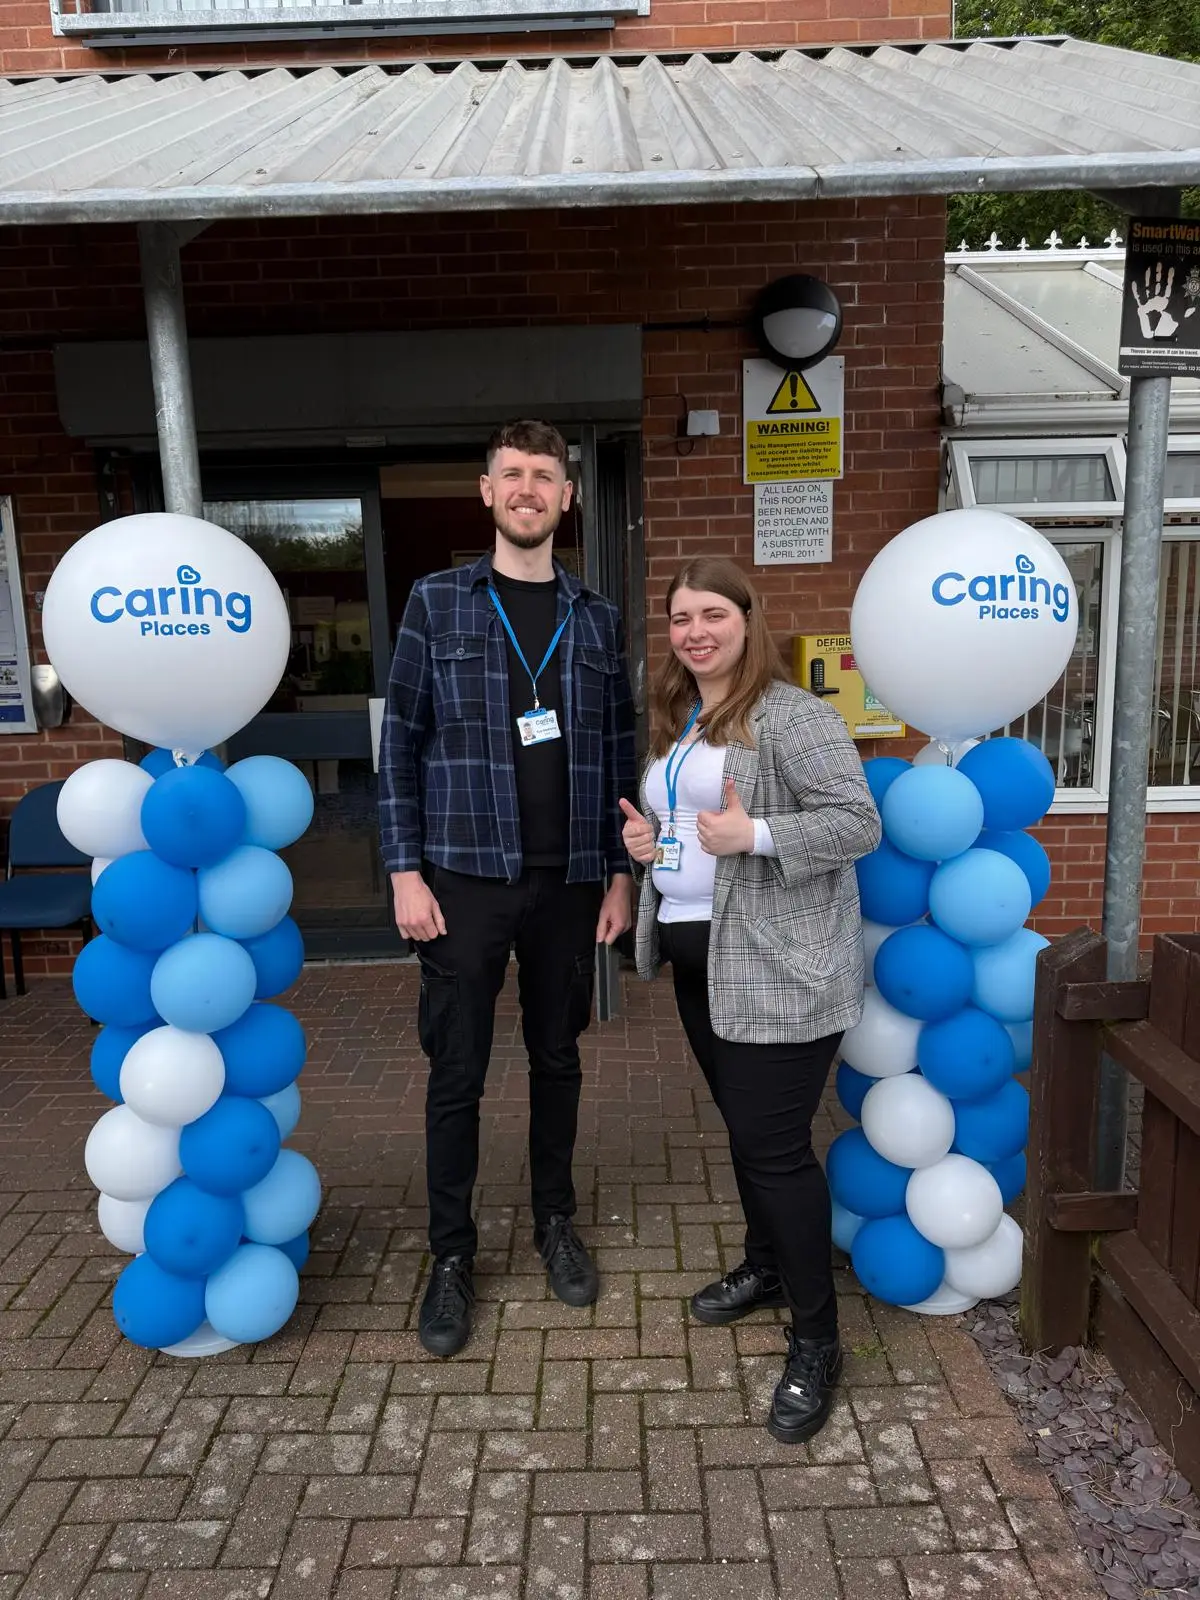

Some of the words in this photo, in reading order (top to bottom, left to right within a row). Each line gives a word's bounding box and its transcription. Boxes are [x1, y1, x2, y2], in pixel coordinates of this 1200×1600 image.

[1142, 242, 1163, 254] used
[1165, 243, 1174, 254] in
[1176, 243, 1190, 255] this
[757, 421, 830, 434] WARNING!
[782, 485, 805, 493] LEAD
[759, 497, 779, 505] THIS
[782, 496, 807, 504] ROOF
[758, 508, 782, 516] BEEN
[784, 506, 829, 515] REMOVED
[773, 518, 808, 526] STOLEN
[757, 529, 804, 538] REPLACED
[770, 538, 824, 548] SUBSTITUTE
[932, 554, 1069, 622] Caring
[90, 565, 252, 633] Caring
[979, 605, 1039, 620] Places
[140, 621, 210, 636] Places
[817, 637, 851, 647] DEFIBR
